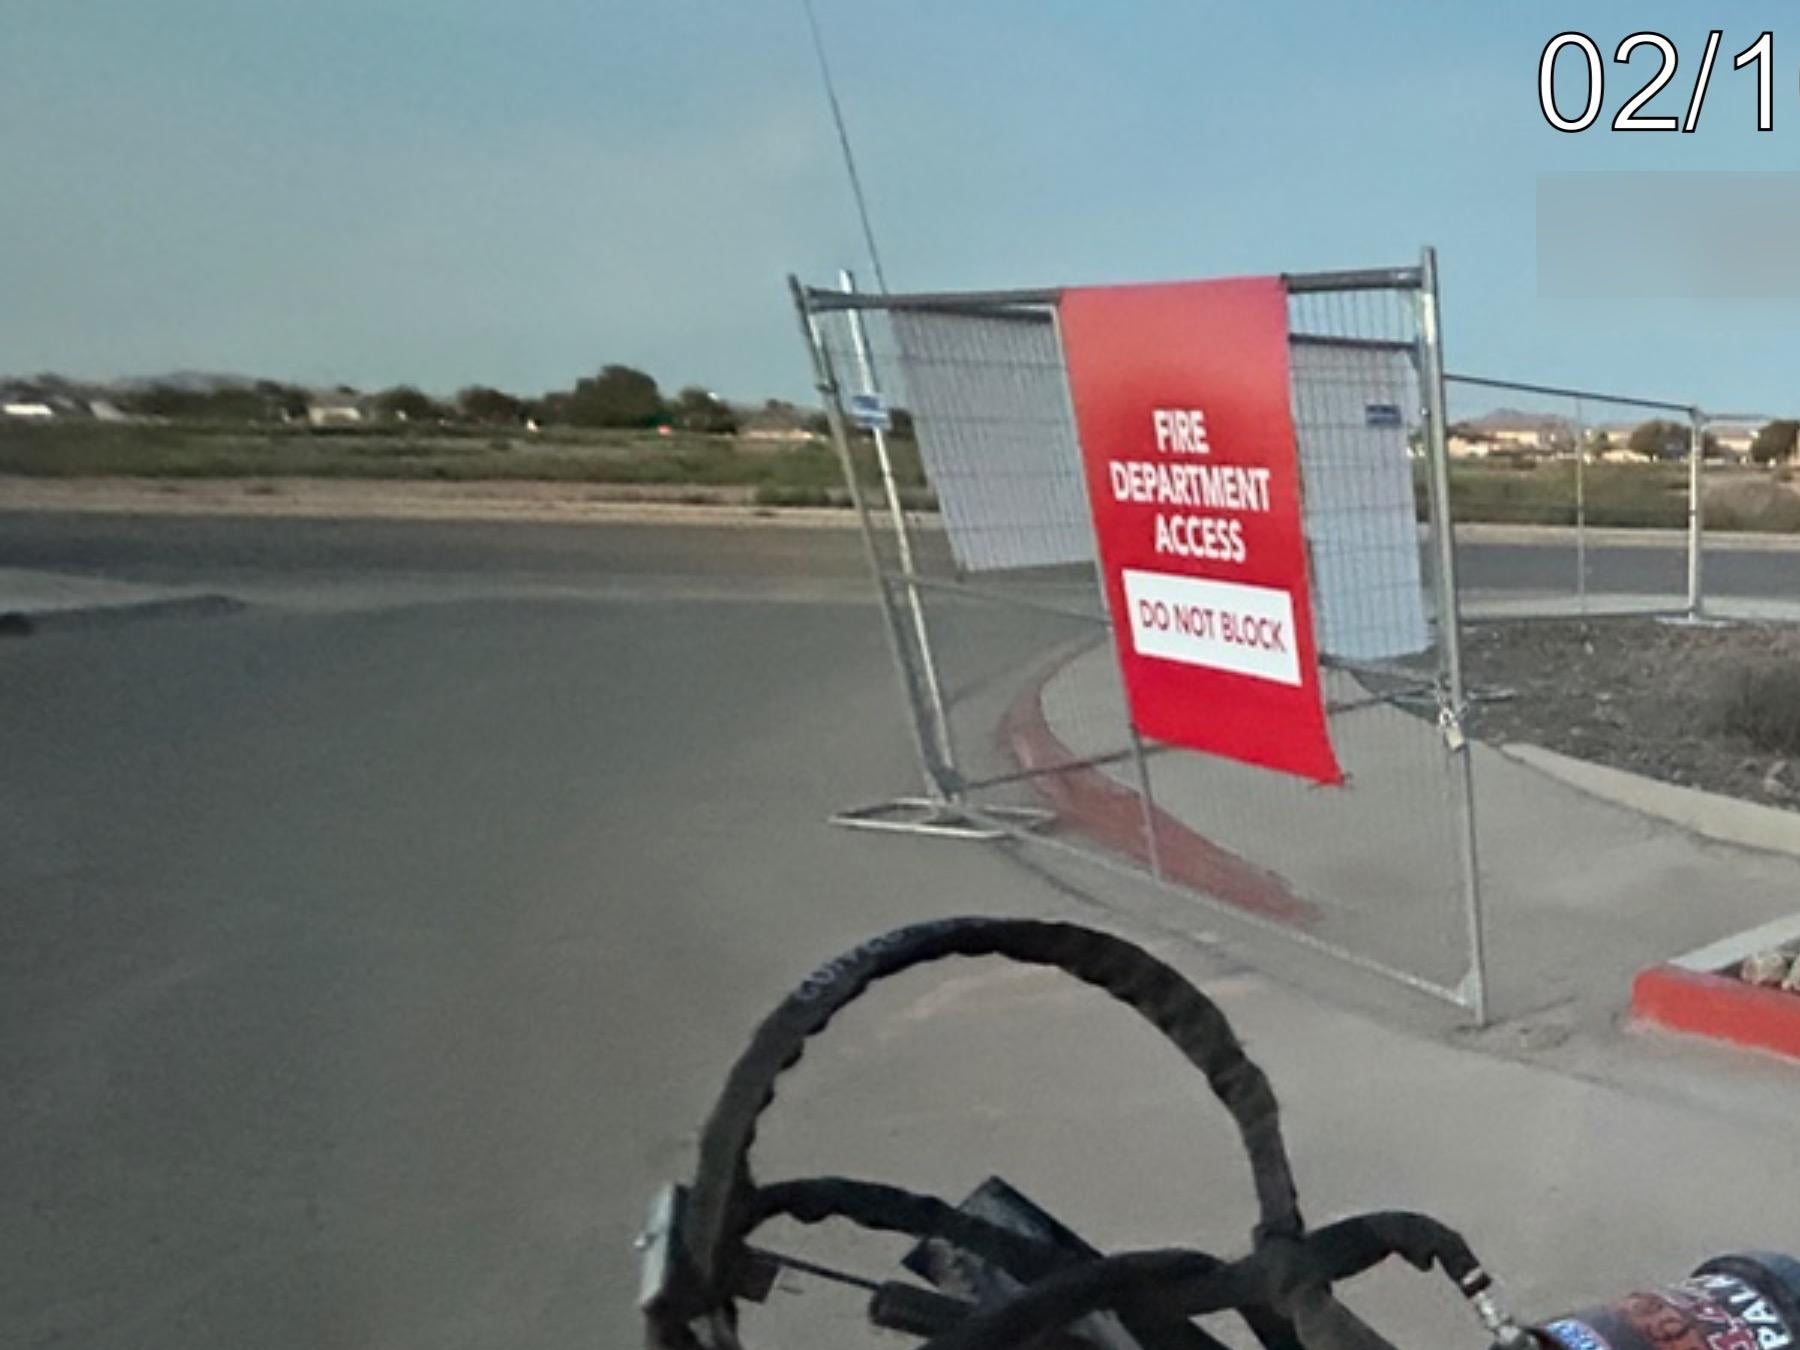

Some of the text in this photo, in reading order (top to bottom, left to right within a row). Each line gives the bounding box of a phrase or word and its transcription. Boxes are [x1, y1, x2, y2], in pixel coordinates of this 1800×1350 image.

[1153, 410, 1210, 454] FIRE
[1108, 461, 1270, 511] DEPARTMENT
[1154, 513, 1246, 563] ACCESS
[1139, 599, 1287, 653] DO NOT BLOCK
